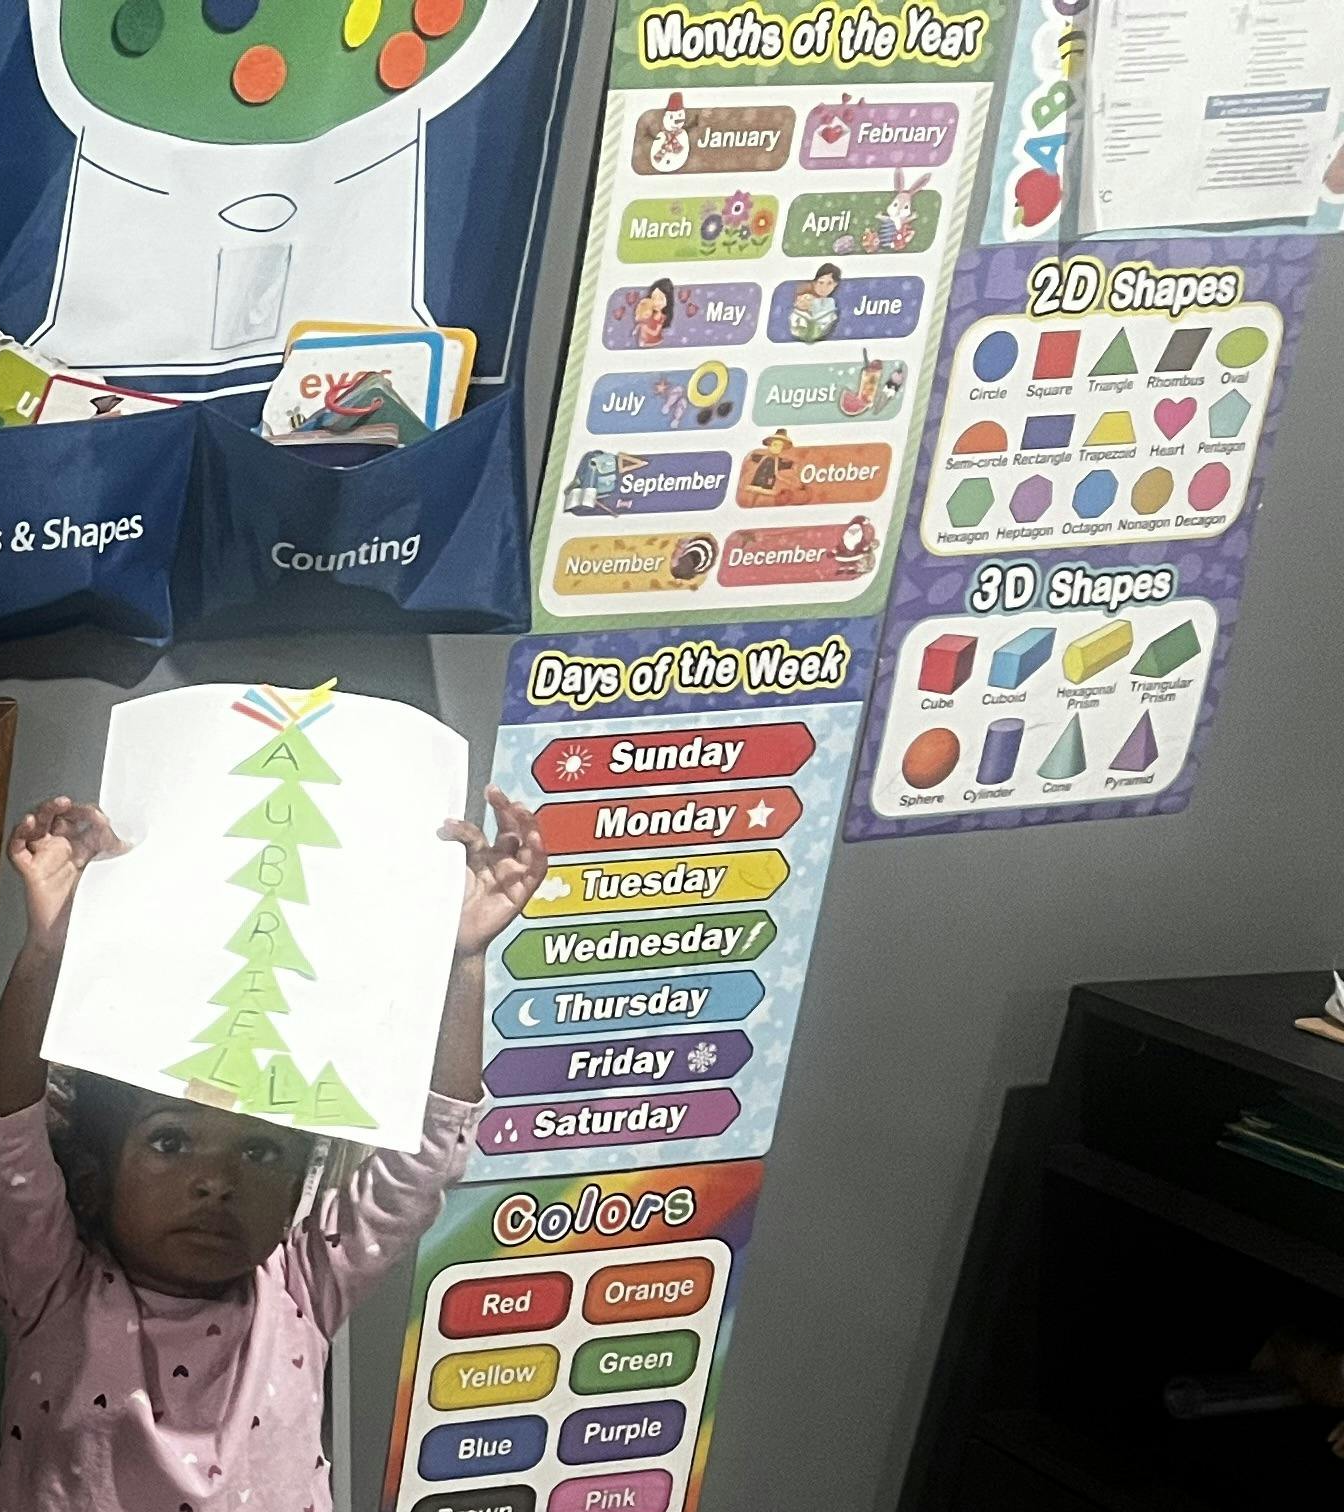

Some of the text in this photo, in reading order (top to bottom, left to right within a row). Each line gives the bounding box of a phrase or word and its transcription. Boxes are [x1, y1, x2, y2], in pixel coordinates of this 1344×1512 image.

[645, 8, 982, 62] Months of the Year
[696, 127, 781, 152] January
[857, 122, 947, 147] February
[629, 217, 692, 239] March
[802, 211, 850, 235] April
[1031, 261, 1238, 316] 2D Shapes
[706, 302, 746, 326] May
[854, 297, 902, 316] June
[1088, 379, 1134, 393] Triangle
[1147, 376, 1205, 388] Rhombus
[1221, 372, 1249, 384] Oval
[766, 384, 836, 405] August
[969, 388, 1007, 400] Circle
[1026, 385, 1073, 399] Square
[602, 393, 645, 416] July
[1079, 448, 1136, 463] Trapezoid
[1150, 444, 1184, 457] Heart
[1198, 441, 1245, 454] Pentagon
[1013, 453, 1072, 467] Rectangle
[800, 464, 879, 484] October
[620, 473, 725, 497] September
[1062, 522, 1112, 535] Octagon
[1117, 518, 1170, 532] Nonagon
[1175, 514, 1226, 528] Decagon
[12, 522, 35, 552] &
[42, 514, 144, 552] Shapes
[937, 530, 989, 543] Hexagon
[996, 526, 1053, 540] Heptagon
[271, 532, 420, 573] Counting
[728, 547, 825, 567] December
[565, 554, 664, 575] November
[971, 564, 1172, 613] 3D Shapes
[533, 643, 845, 703] Days of the Week
[1057, 683, 1116, 699] Hexagonal
[1130, 678, 1193, 692] Triangular
[921, 698, 954, 710] Cube
[982, 692, 1026, 706] Cuboid
[1067, 698, 1100, 710] Prism
[1141, 692, 1176, 703] Prism
[609, 737, 744, 774] Sunday
[1105, 774, 1155, 788] Pyramid
[900, 794, 944, 808] Sphere
[963, 787, 1015, 802] Cylinder
[594, 803, 738, 839] Monday
[581, 865, 726, 901] Tuesday
[544, 924, 743, 965] Wednesday
[555, 987, 709, 1024] Thursday
[567, 1049, 674, 1081] Friday
[533, 1103, 688, 1139] Saturday
[493, 1184, 695, 1246] Colors
[605, 1279, 695, 1303] Orange
[482, 1293, 530, 1316] Red
[599, 1350, 673, 1373] Green
[457, 1365, 536, 1389] Yellow
[584, 1419, 662, 1447] Purple
[458, 1439, 512, 1459] Blue
[585, 1489, 636, 1511] Pink
